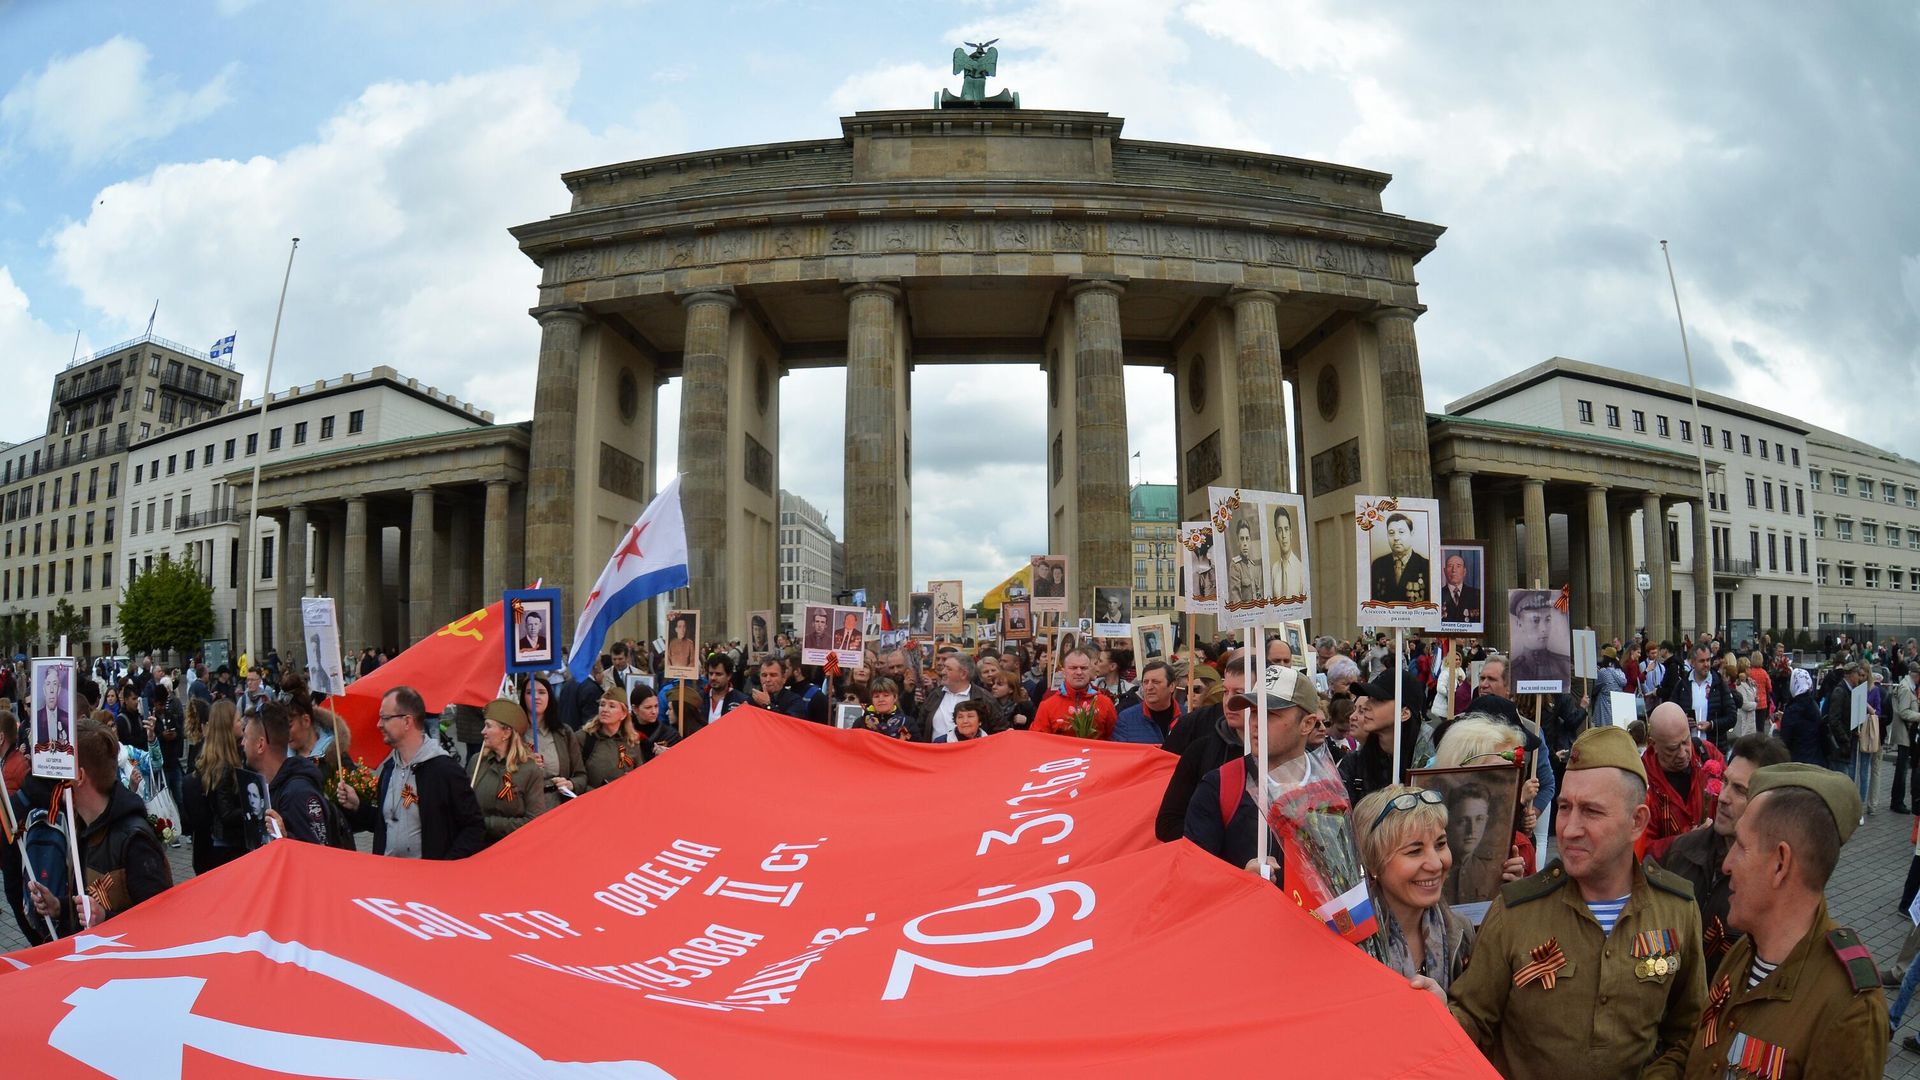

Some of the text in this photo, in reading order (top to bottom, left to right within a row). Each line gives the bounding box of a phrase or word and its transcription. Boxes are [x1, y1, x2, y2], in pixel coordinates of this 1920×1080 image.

[352, 897, 492, 940] 150
[593, 839, 722, 916] ОРДЕНА
[881, 881, 1096, 1000] 79
